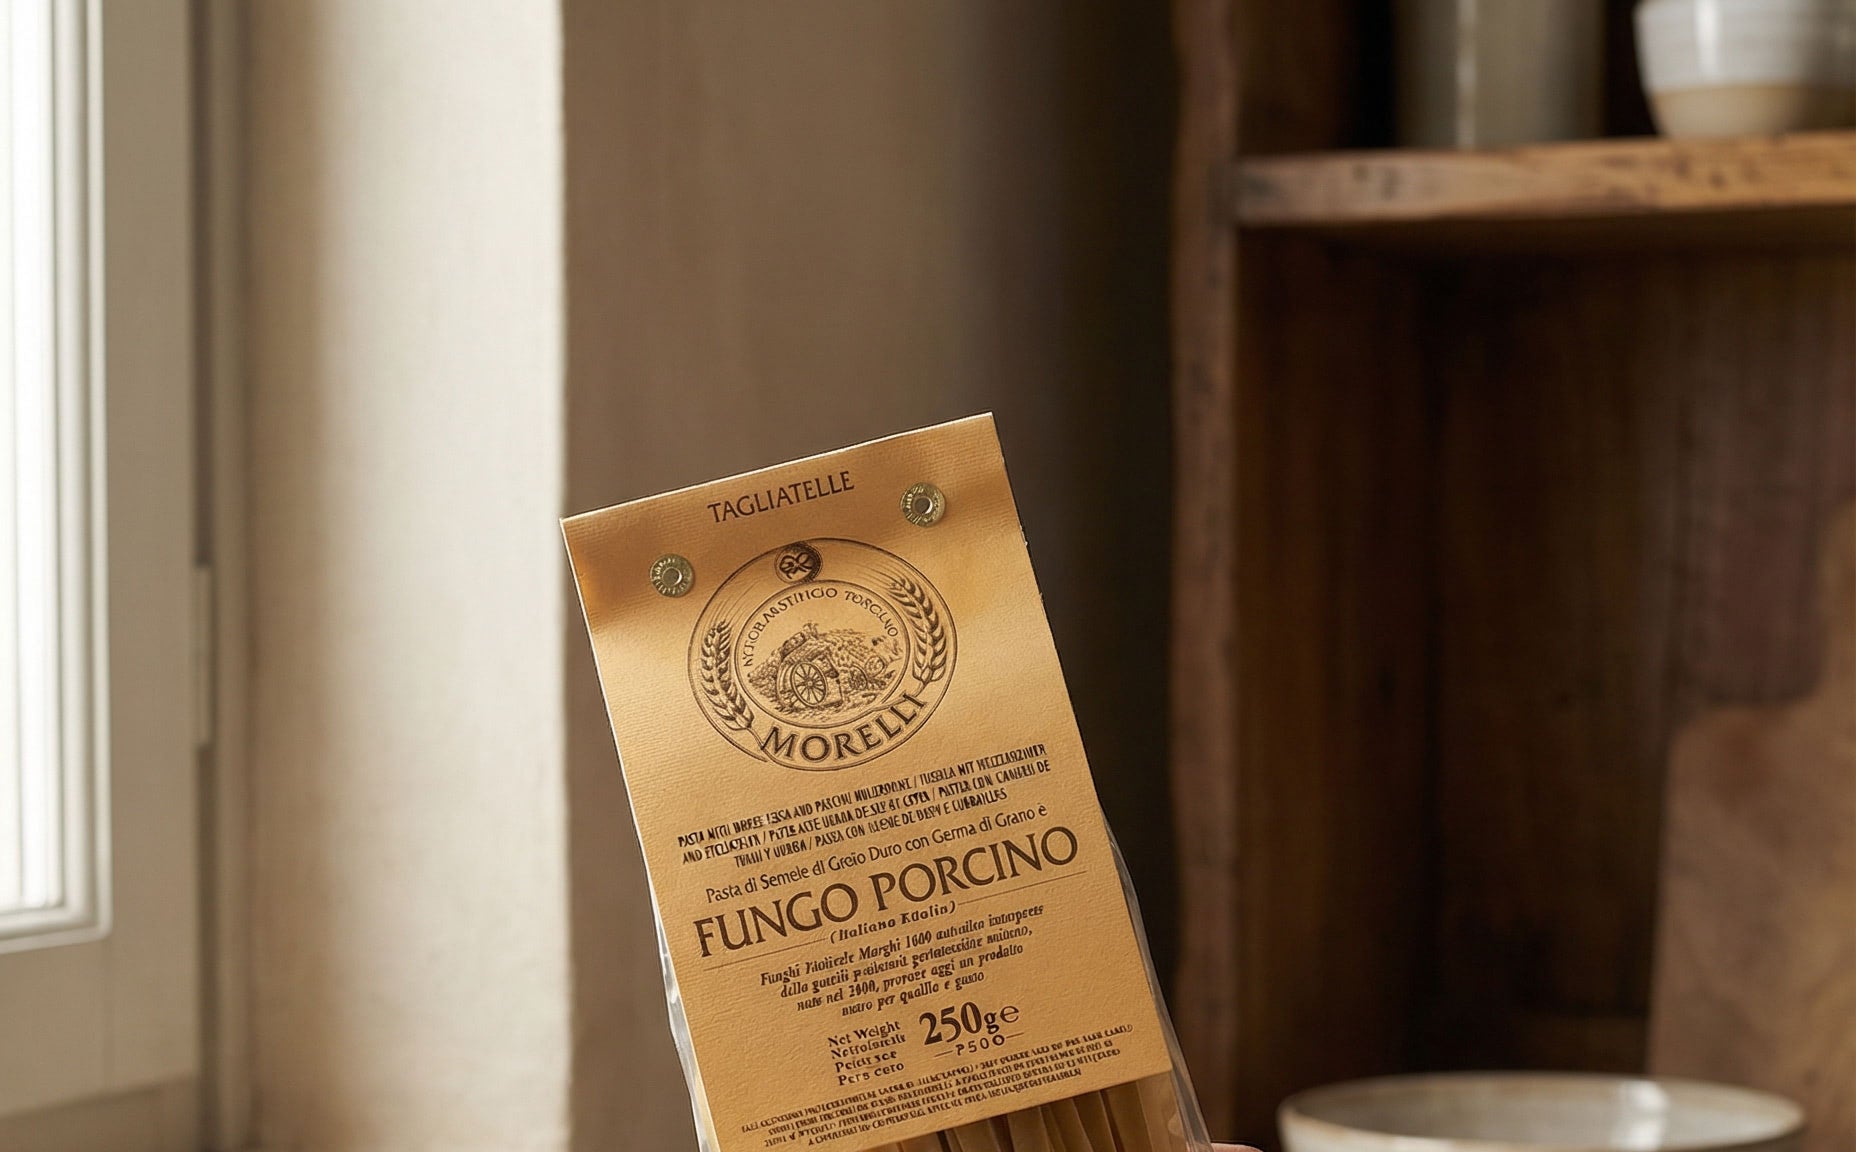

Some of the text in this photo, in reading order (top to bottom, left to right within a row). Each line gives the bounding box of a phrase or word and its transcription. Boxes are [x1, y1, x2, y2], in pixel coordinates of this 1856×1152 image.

[706, 470, 854, 522] TAGLIATELLE
[760, 692, 927, 761] MORELLI
[1035, 758, 1051, 773] DE
[844, 823, 866, 839] CON
[941, 800, 951, 814] E
[704, 883, 743, 904] Pasta
[758, 865, 810, 890] Semele
[867, 842, 902, 861] Duro
[903, 835, 930, 852] con
[930, 823, 977, 844] Germa
[993, 808, 1036, 828] Grano
[694, 882, 858, 957] FUNGO
[870, 826, 1077, 910] PORCINO
[759, 962, 800, 986] Funghi
